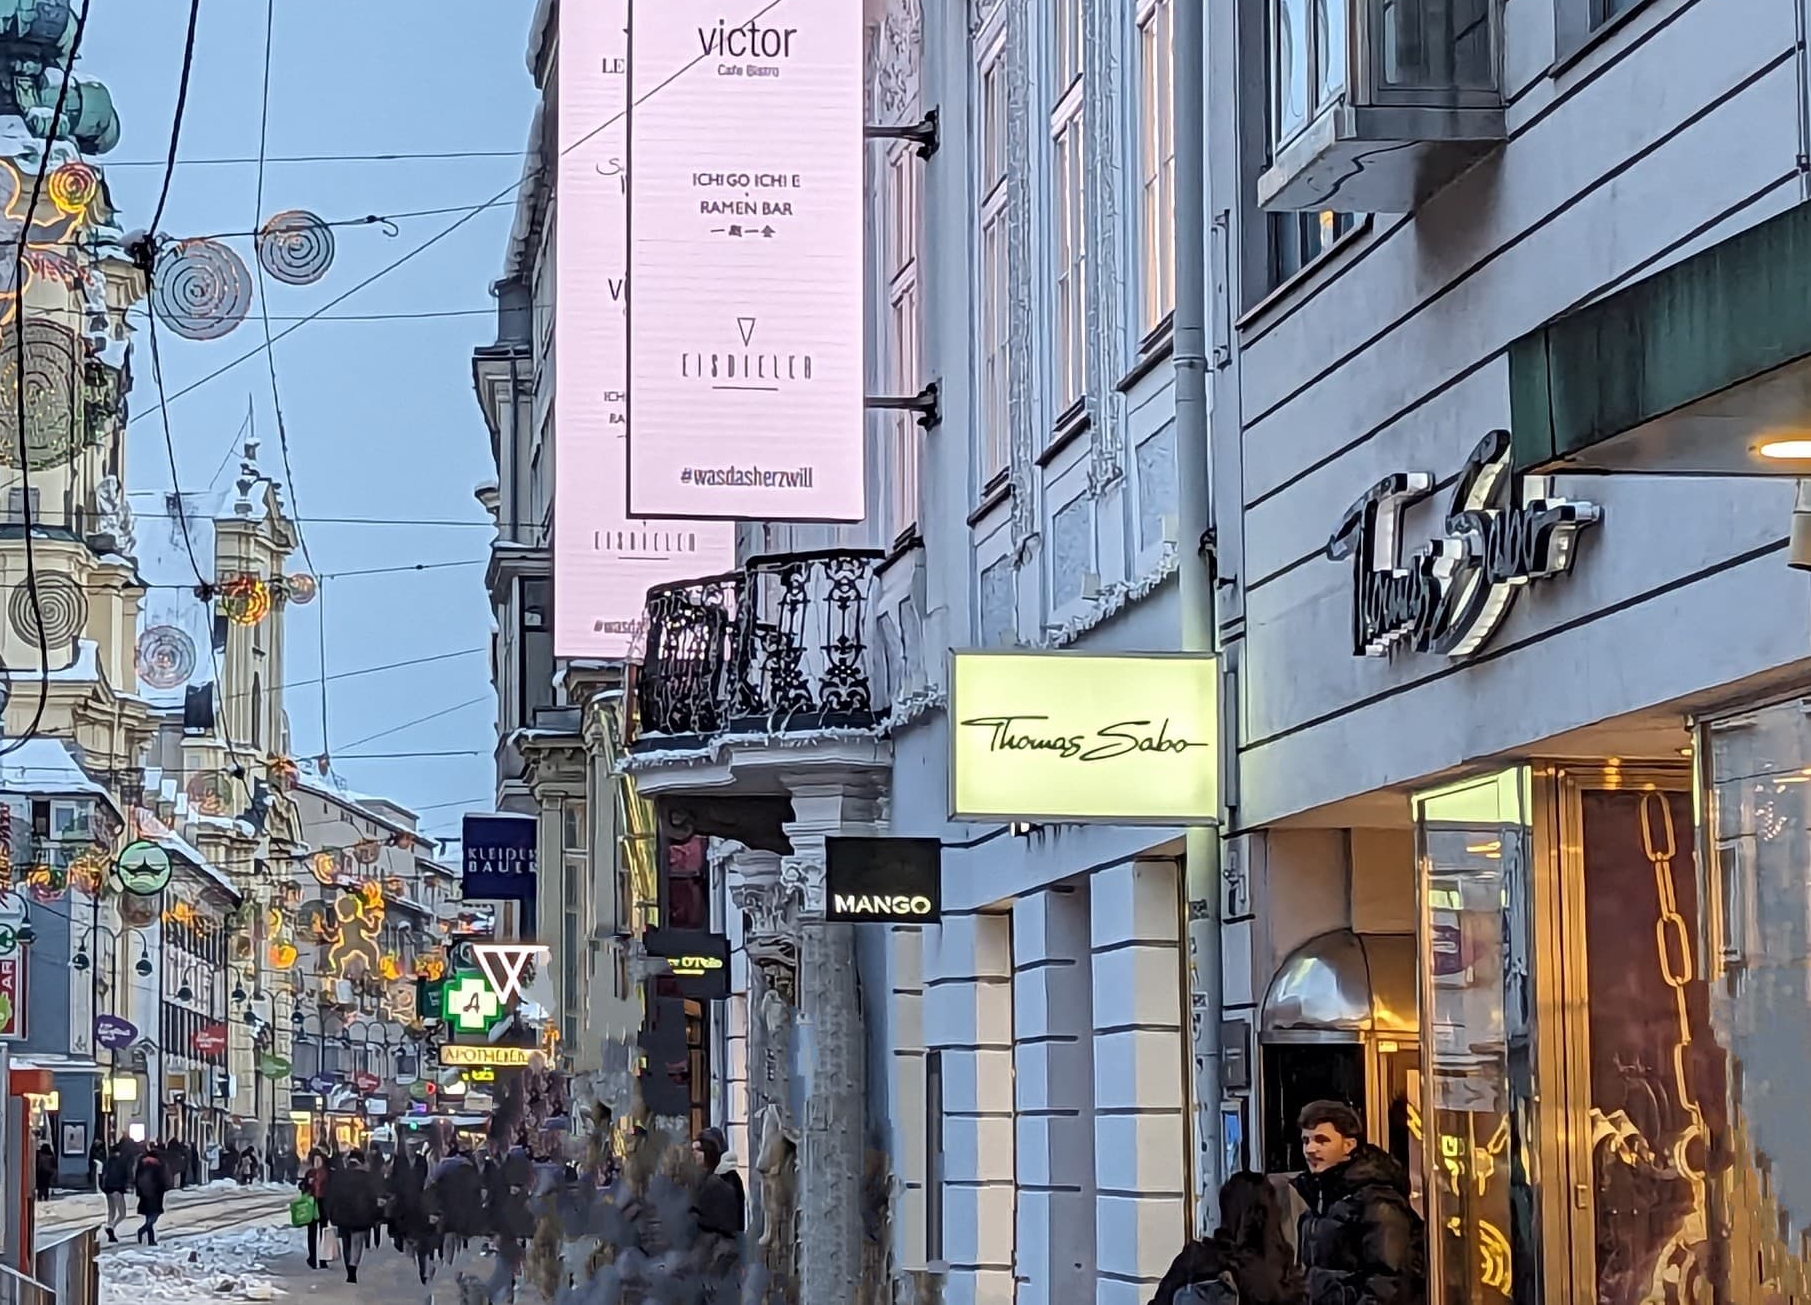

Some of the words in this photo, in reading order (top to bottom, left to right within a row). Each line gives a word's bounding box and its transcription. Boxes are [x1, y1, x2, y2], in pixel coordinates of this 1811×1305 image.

[698, 19, 798, 57] victor
[700, 201, 757, 215] RAMEN
[762, 201, 793, 215] BAR
[681, 465, 813, 488] #wasdasherzwill
[961, 714, 1084, 758] Thomas
[1079, 718, 1208, 761] Sabo
[835, 894, 932, 915] MANGO
